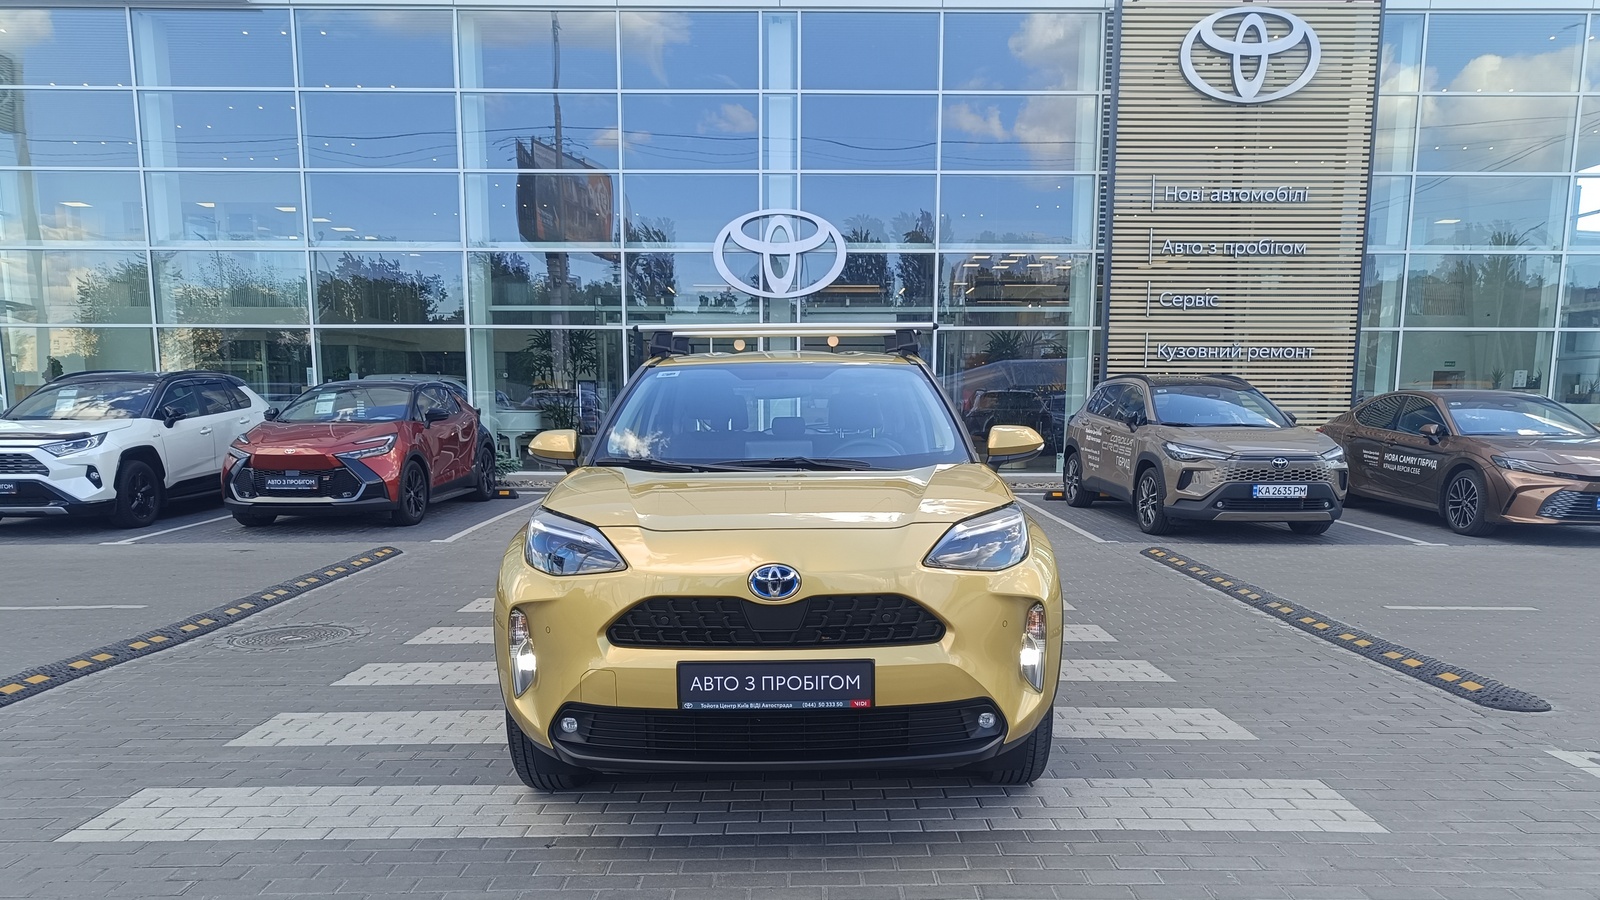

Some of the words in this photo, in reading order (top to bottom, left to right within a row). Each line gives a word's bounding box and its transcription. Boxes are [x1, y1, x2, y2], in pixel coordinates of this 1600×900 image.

[1164, 185, 1205, 202] Нові
[1210, 185, 1310, 203] автомобілі
[1161, 239, 1203, 255] Авто
[1208, 243, 1217, 255] з
[1223, 239, 1307, 258] пробігом
[1159, 291, 1220, 310] Сервіс
[1156, 343, 1243, 362] Кузовний
[1247, 347, 1315, 362] ремонт
[1102, 441, 1132, 457] CROSS
[1384, 453, 1398, 462] НОВА
[1399, 454, 1418, 466] CAMRY
[1272, 486, 1292, 496] 2635
[690, 676, 739, 691] АВТО
[744, 676, 756, 691] З
[761, 674, 861, 691] ПРОБІГОМ
[802, 701, 817, 709] (044)
